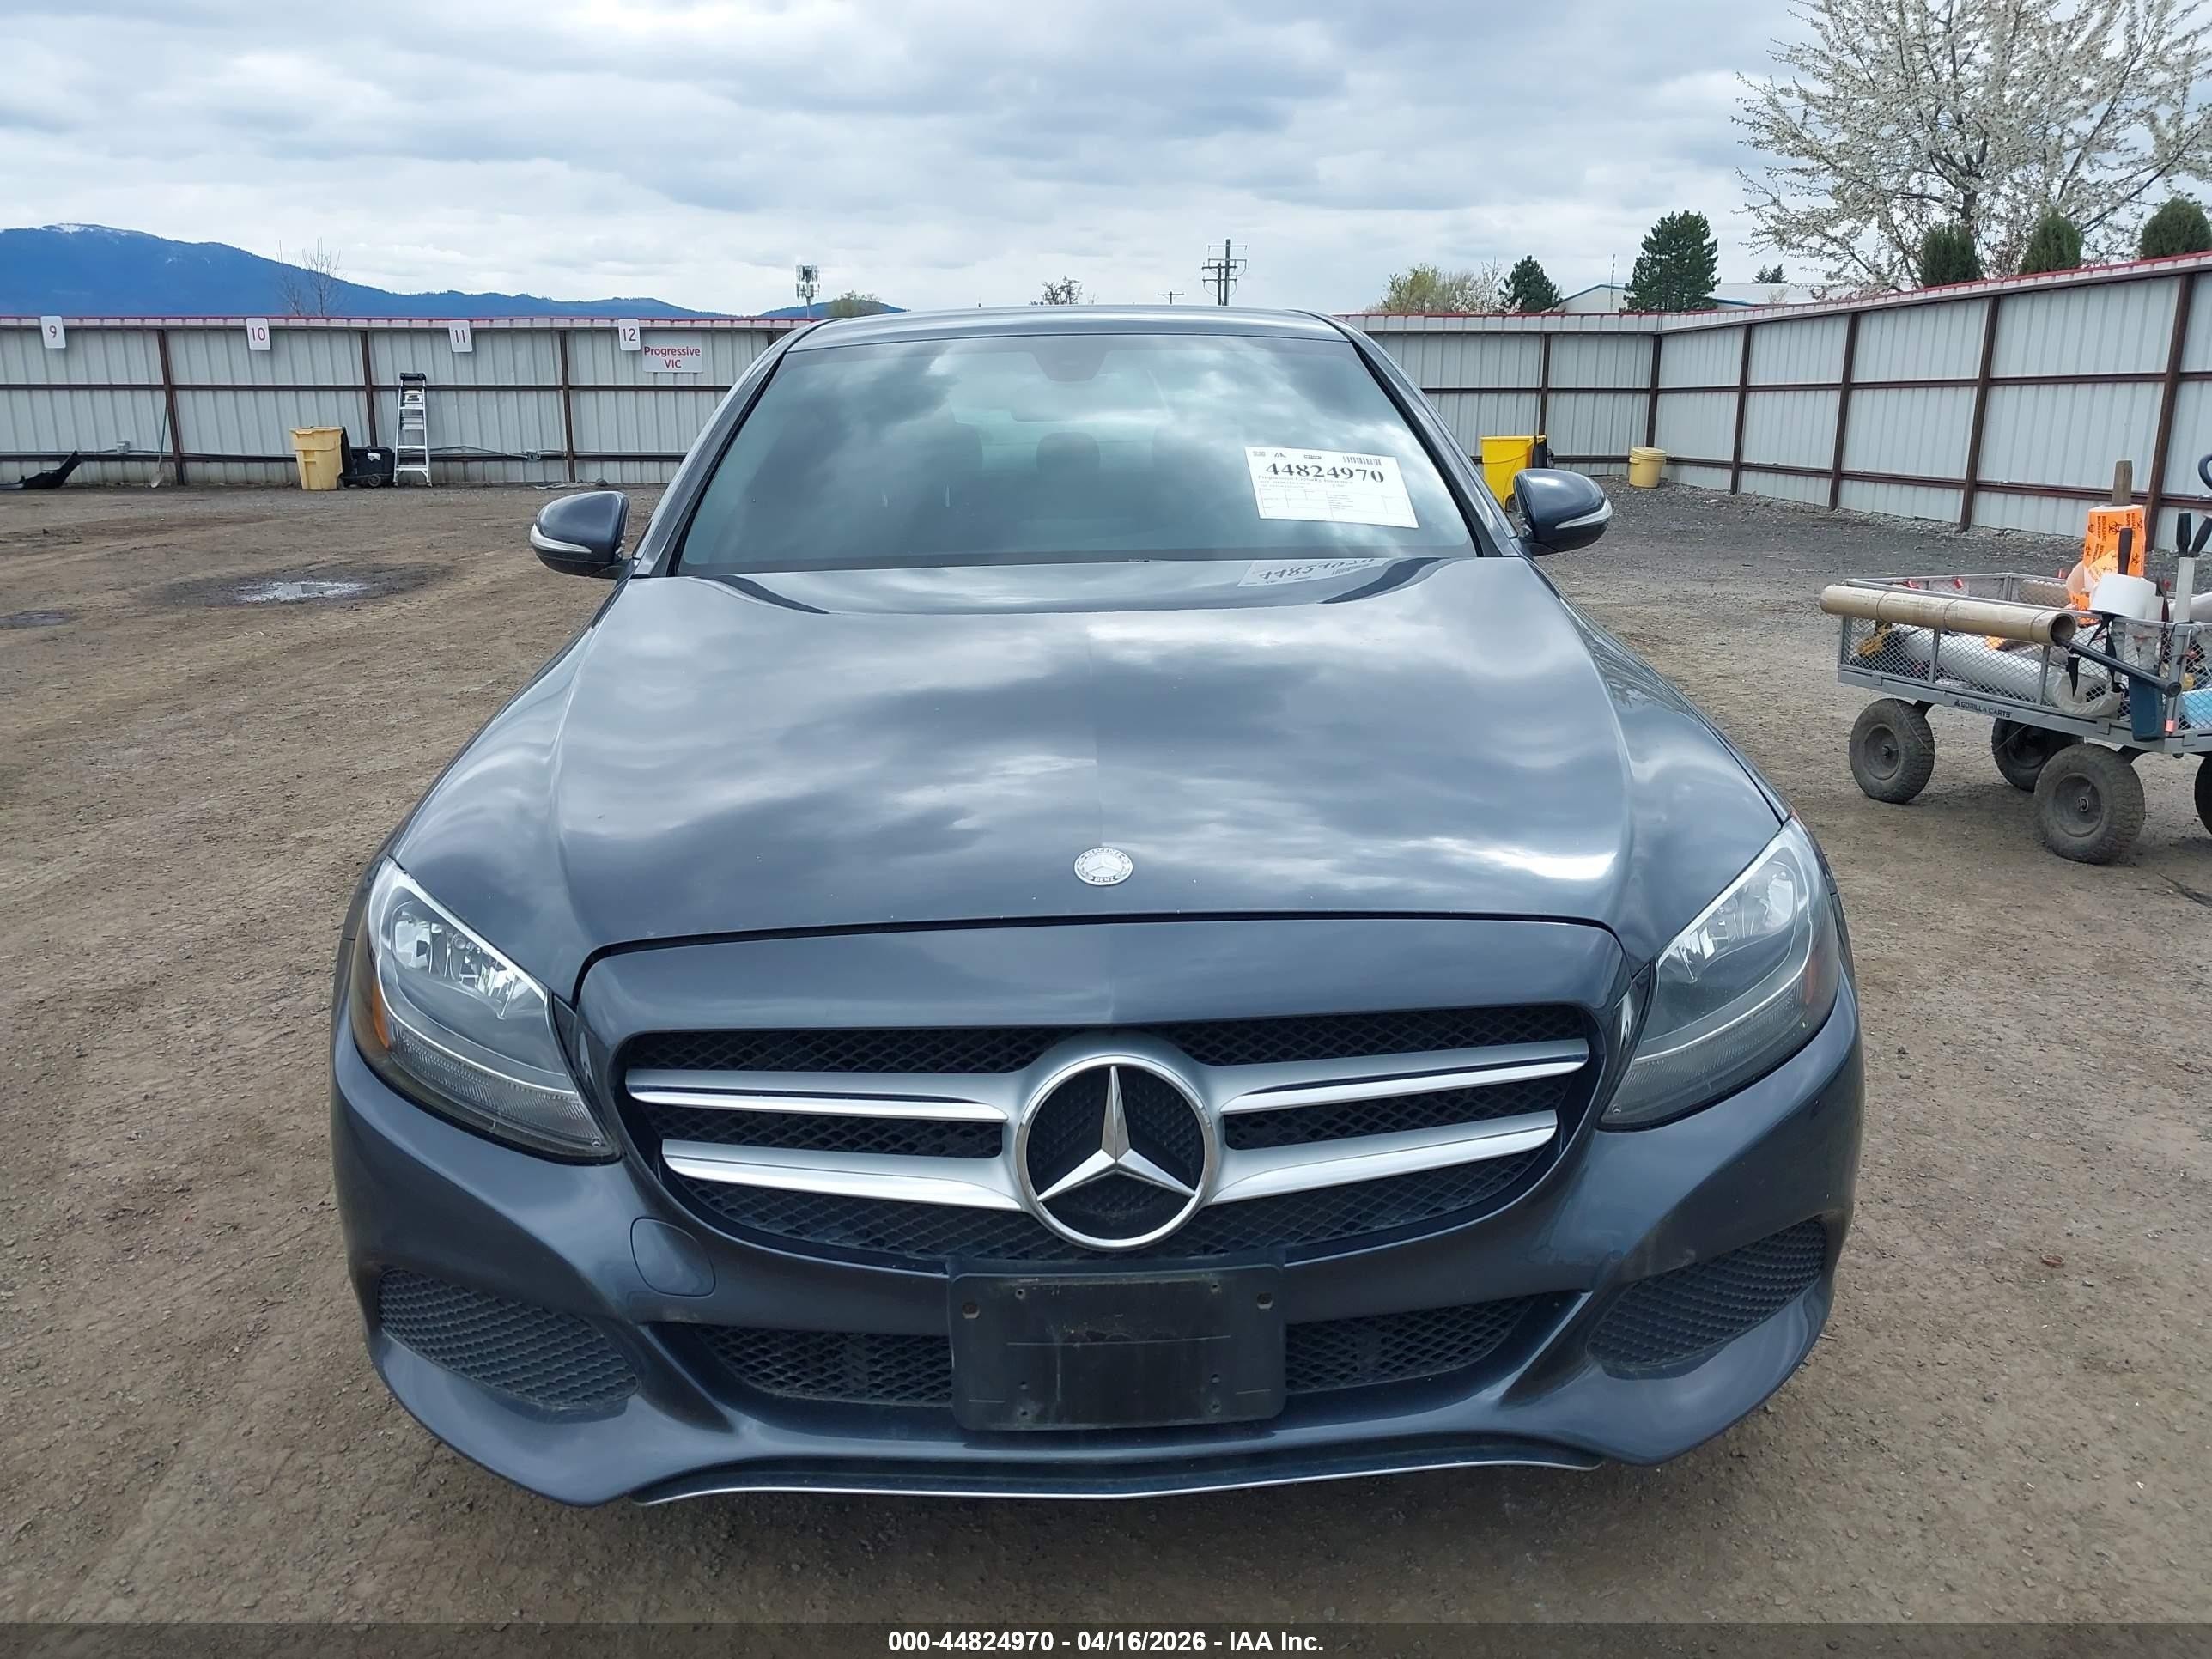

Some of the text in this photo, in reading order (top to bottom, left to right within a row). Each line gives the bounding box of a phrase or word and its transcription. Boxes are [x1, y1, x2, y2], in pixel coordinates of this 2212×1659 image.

[49, 325, 57, 338] 9
[251, 327, 265, 341] 10
[454, 329, 465, 343] 11
[623, 328, 636, 342] 12
[644, 346, 701, 357] Progressive
[665, 359, 682, 368] VIC
[1266, 462, 1384, 483] 44824970
[1960, 701, 2011, 718] GORILLA CARTS
